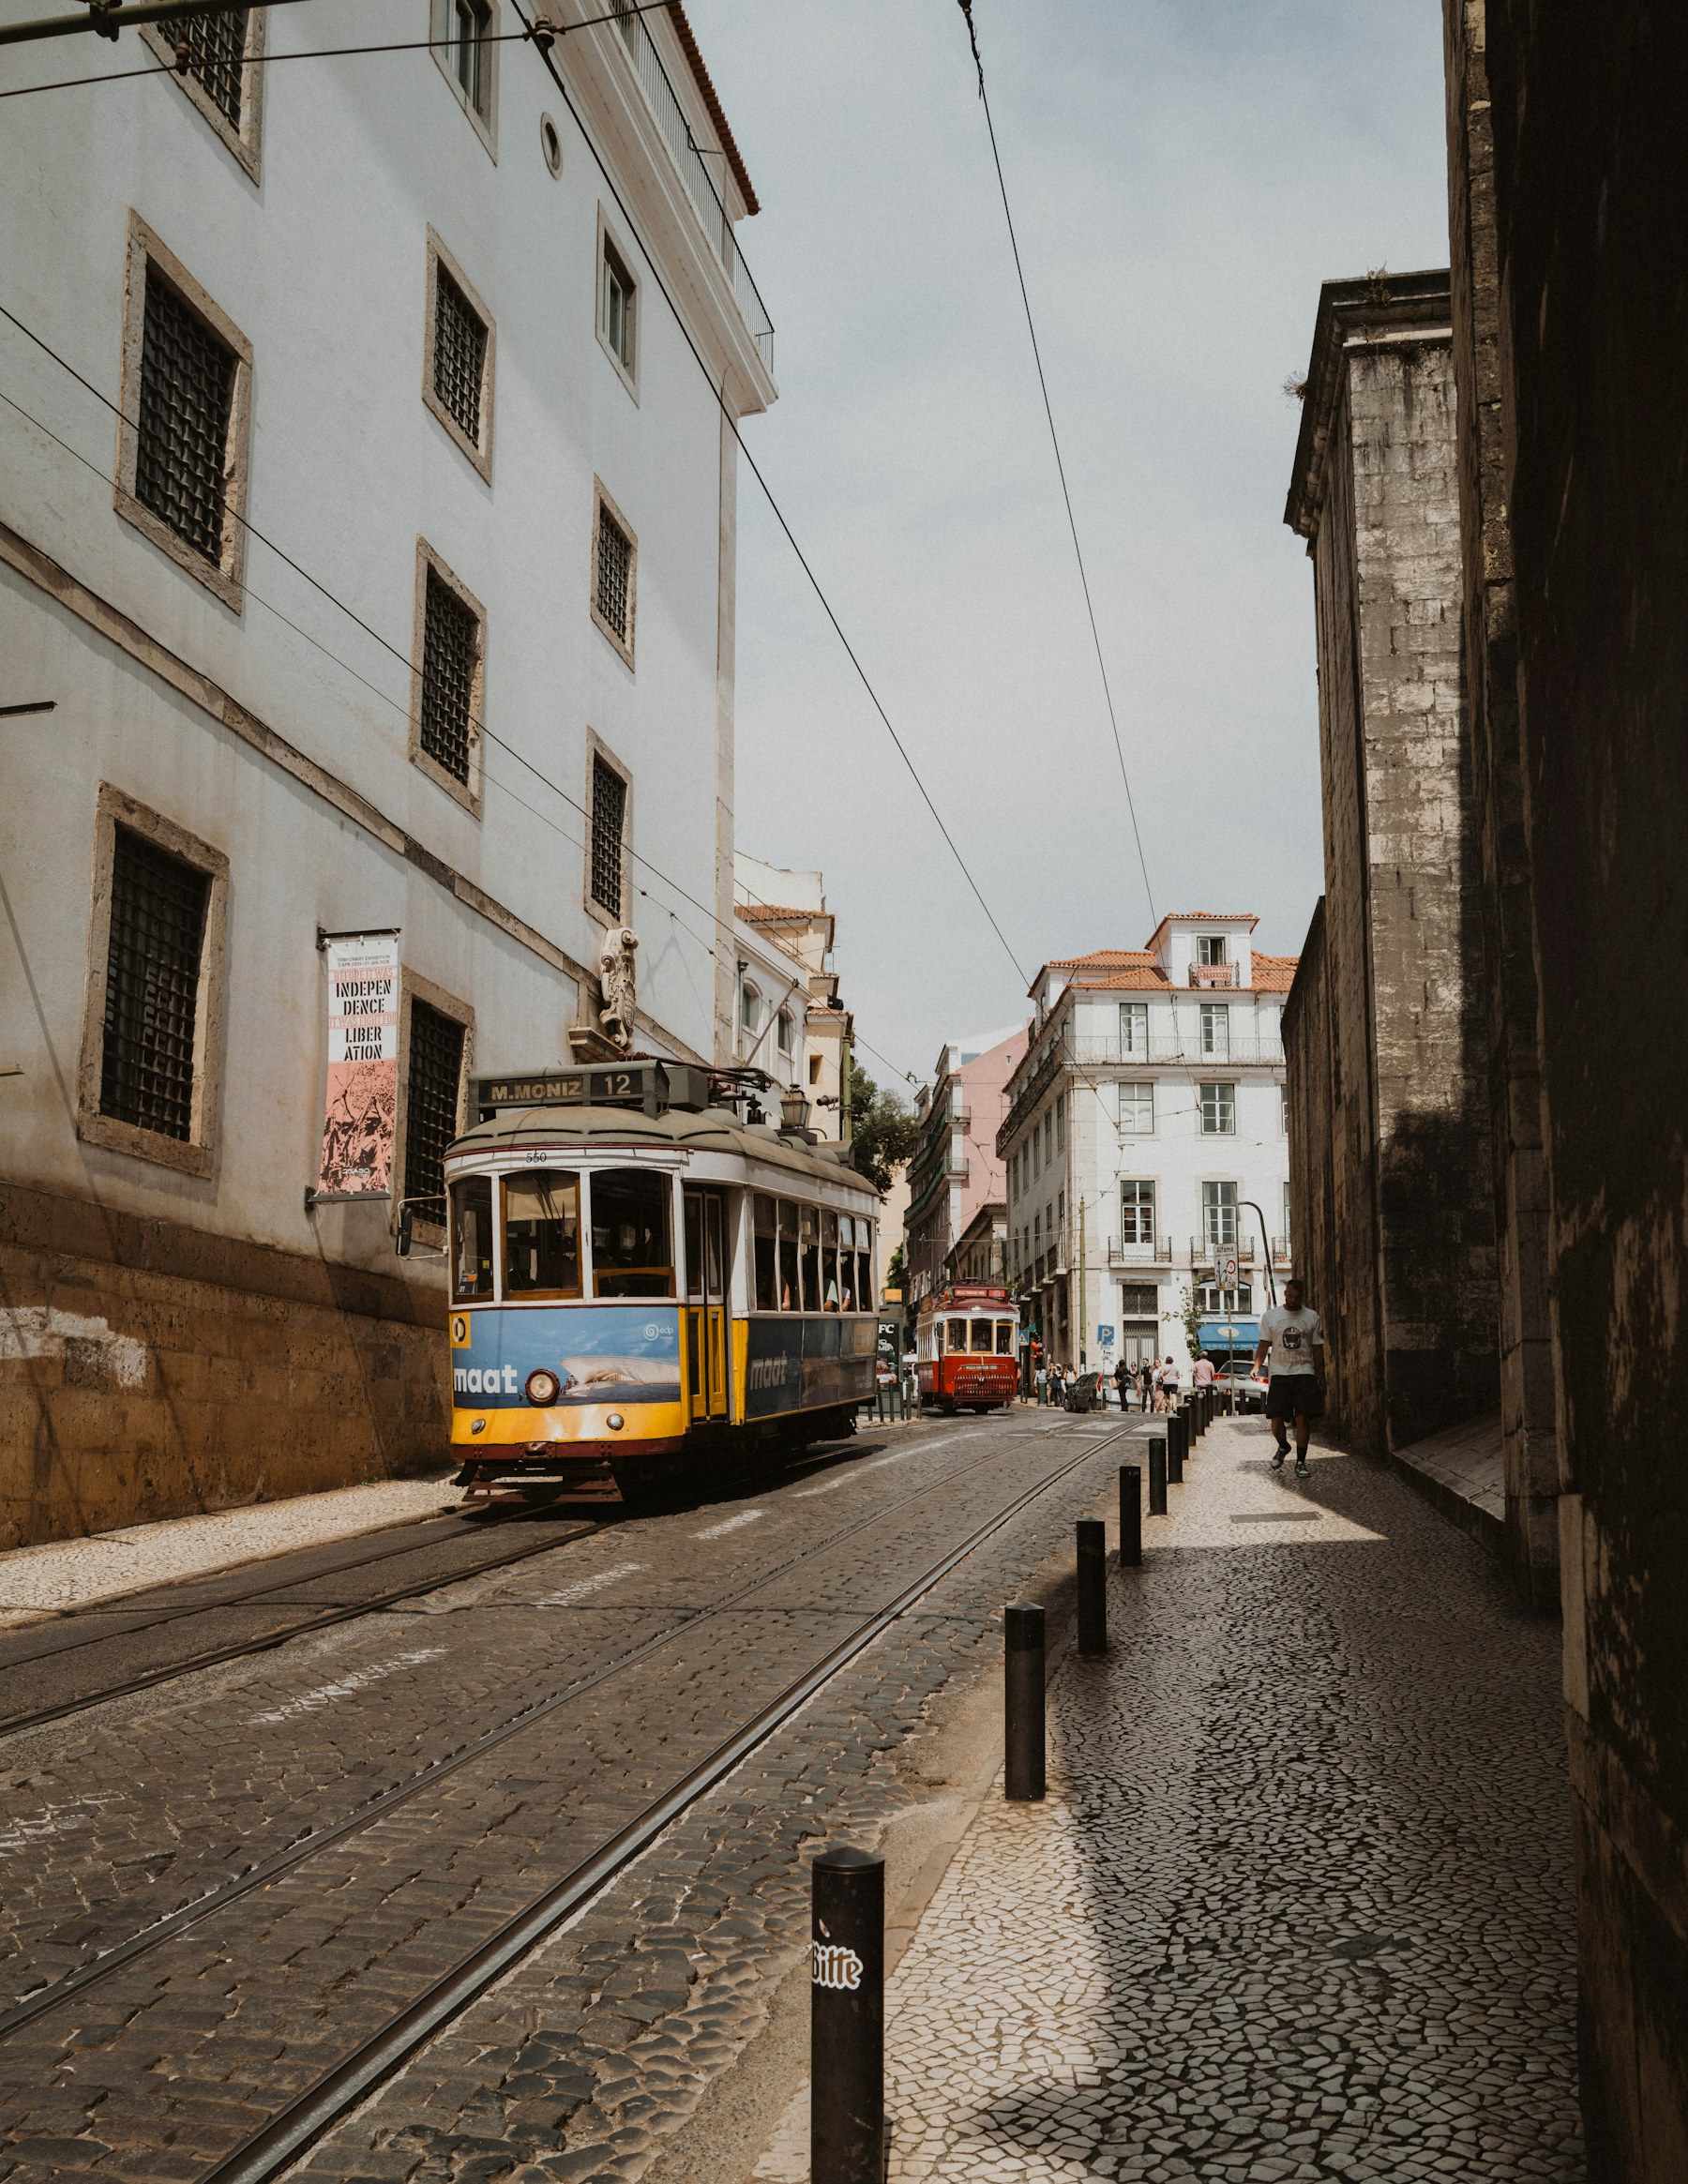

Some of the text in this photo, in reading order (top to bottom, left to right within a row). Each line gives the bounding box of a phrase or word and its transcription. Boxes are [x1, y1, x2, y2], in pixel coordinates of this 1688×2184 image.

[334, 968, 393, 981] BEFORE IT WAS
[336, 979, 391, 998] INDEPEN
[343, 999, 384, 1016] DENCE
[330, 1014, 397, 1028] IT WAS FIGHT FOR
[345, 1026, 382, 1043] LIBER
[343, 1045, 383, 1062] ATION
[490, 1081, 582, 1101] M.MONIZ
[604, 1074, 631, 1095] 12
[525, 1152, 548, 1164] 550
[659, 1325, 674, 1335] edp
[453, 1364, 518, 1394] maat
[749, 1350, 788, 1391] maat
